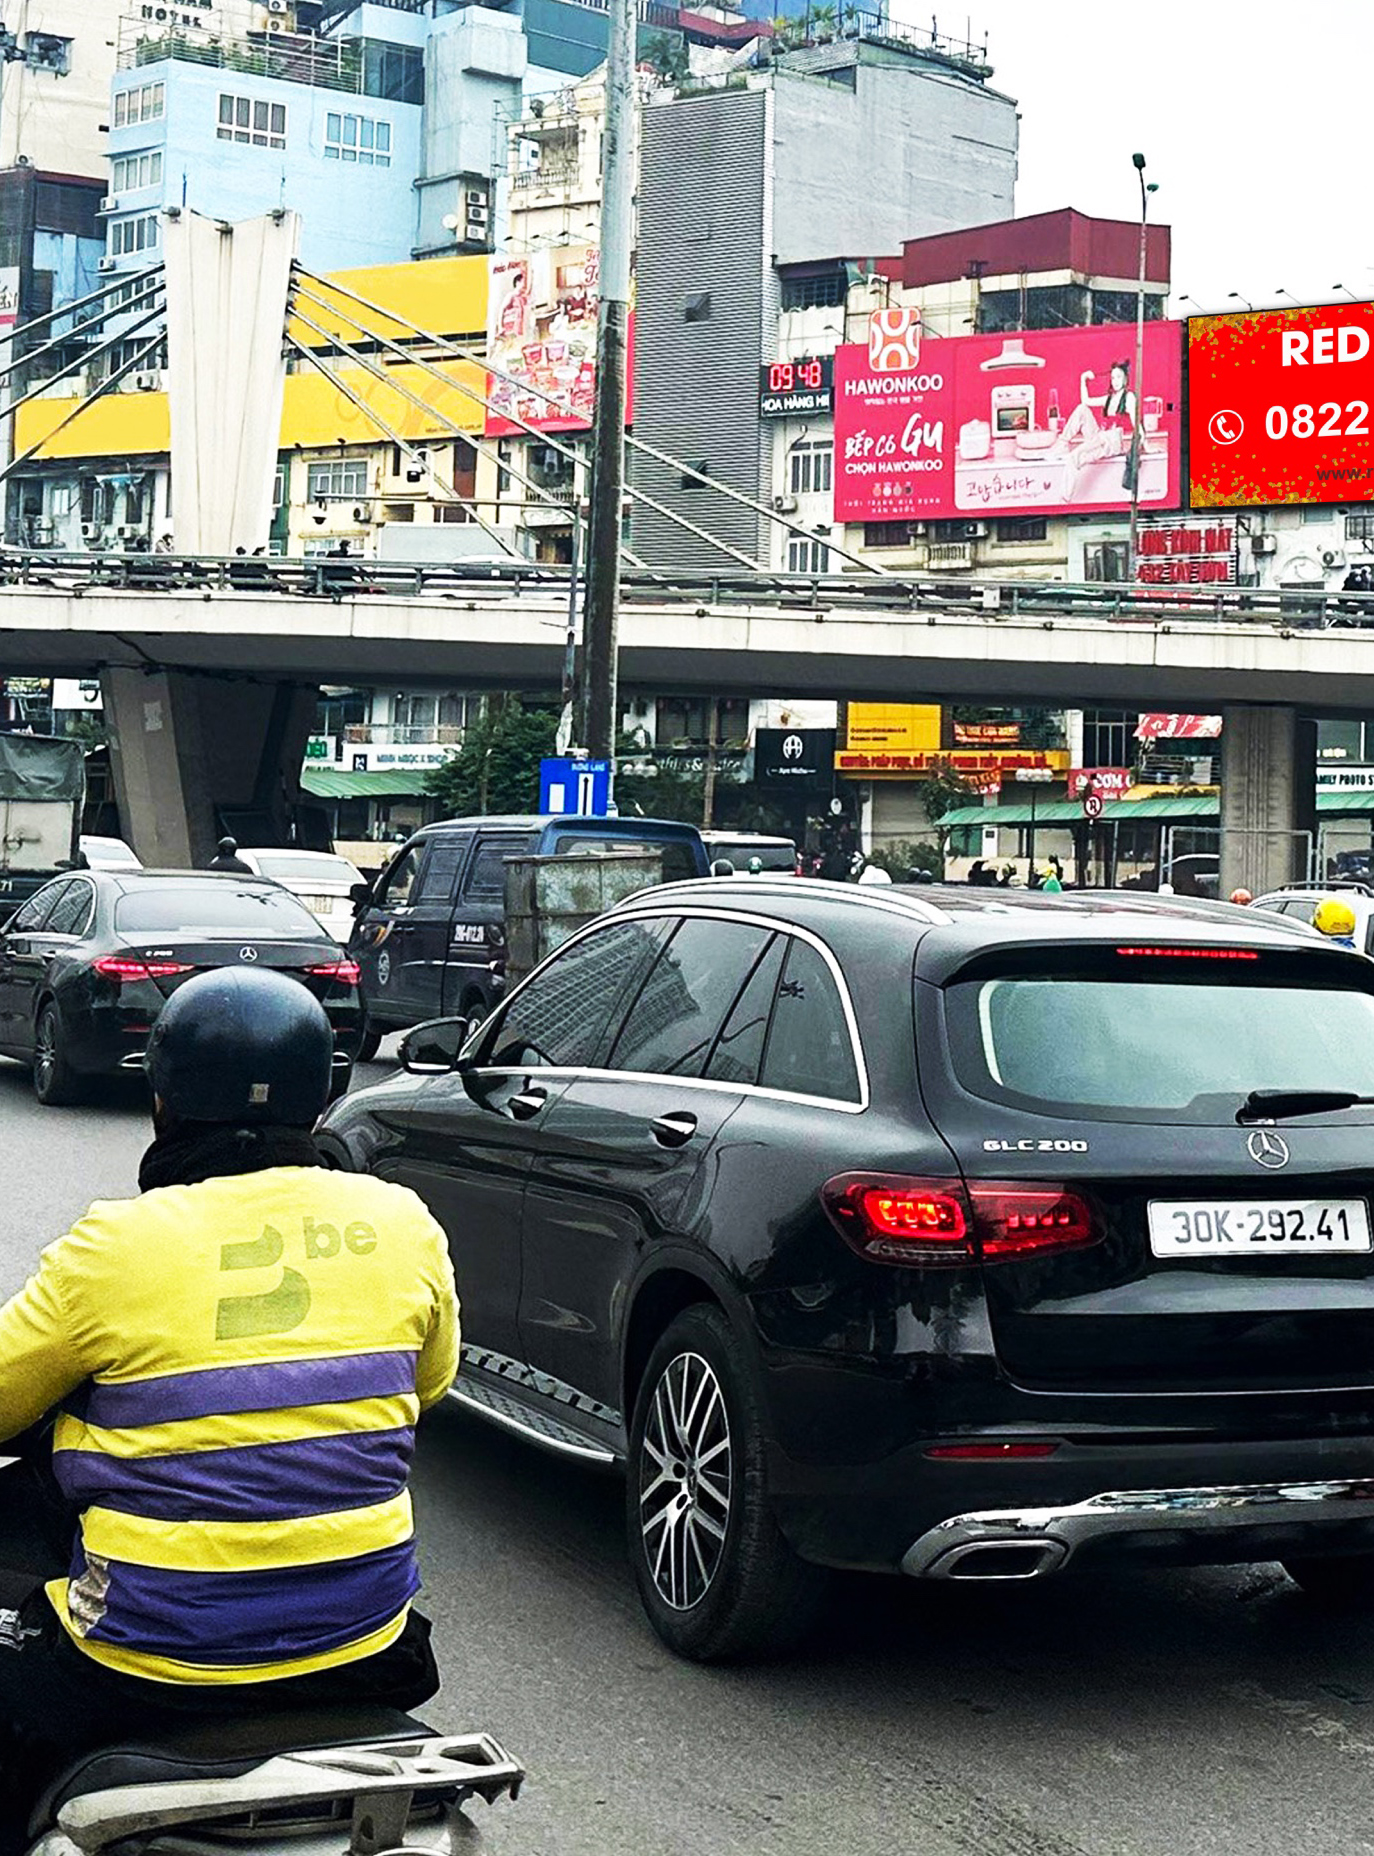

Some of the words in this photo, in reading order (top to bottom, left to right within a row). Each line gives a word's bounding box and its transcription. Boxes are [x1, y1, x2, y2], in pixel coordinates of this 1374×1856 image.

[1281, 326, 1370, 367] RED
[770, 364, 793, 391] 09
[797, 361, 821, 387] 48
[845, 374, 943, 396] HAWONKOO
[1265, 400, 1370, 440] 0822
[845, 429, 874, 459] BẾP
[845, 461, 876, 476] CHỌN
[878, 459, 943, 474] HAWONKOO
[1339, 774, 1366, 785] PHOTO
[983, 1139, 1035, 1152] GLC
[1037, 1139, 1088, 1152] 200
[302, 1216, 378, 1260] be
[1172, 1208, 1350, 1243] 30K-292.41
